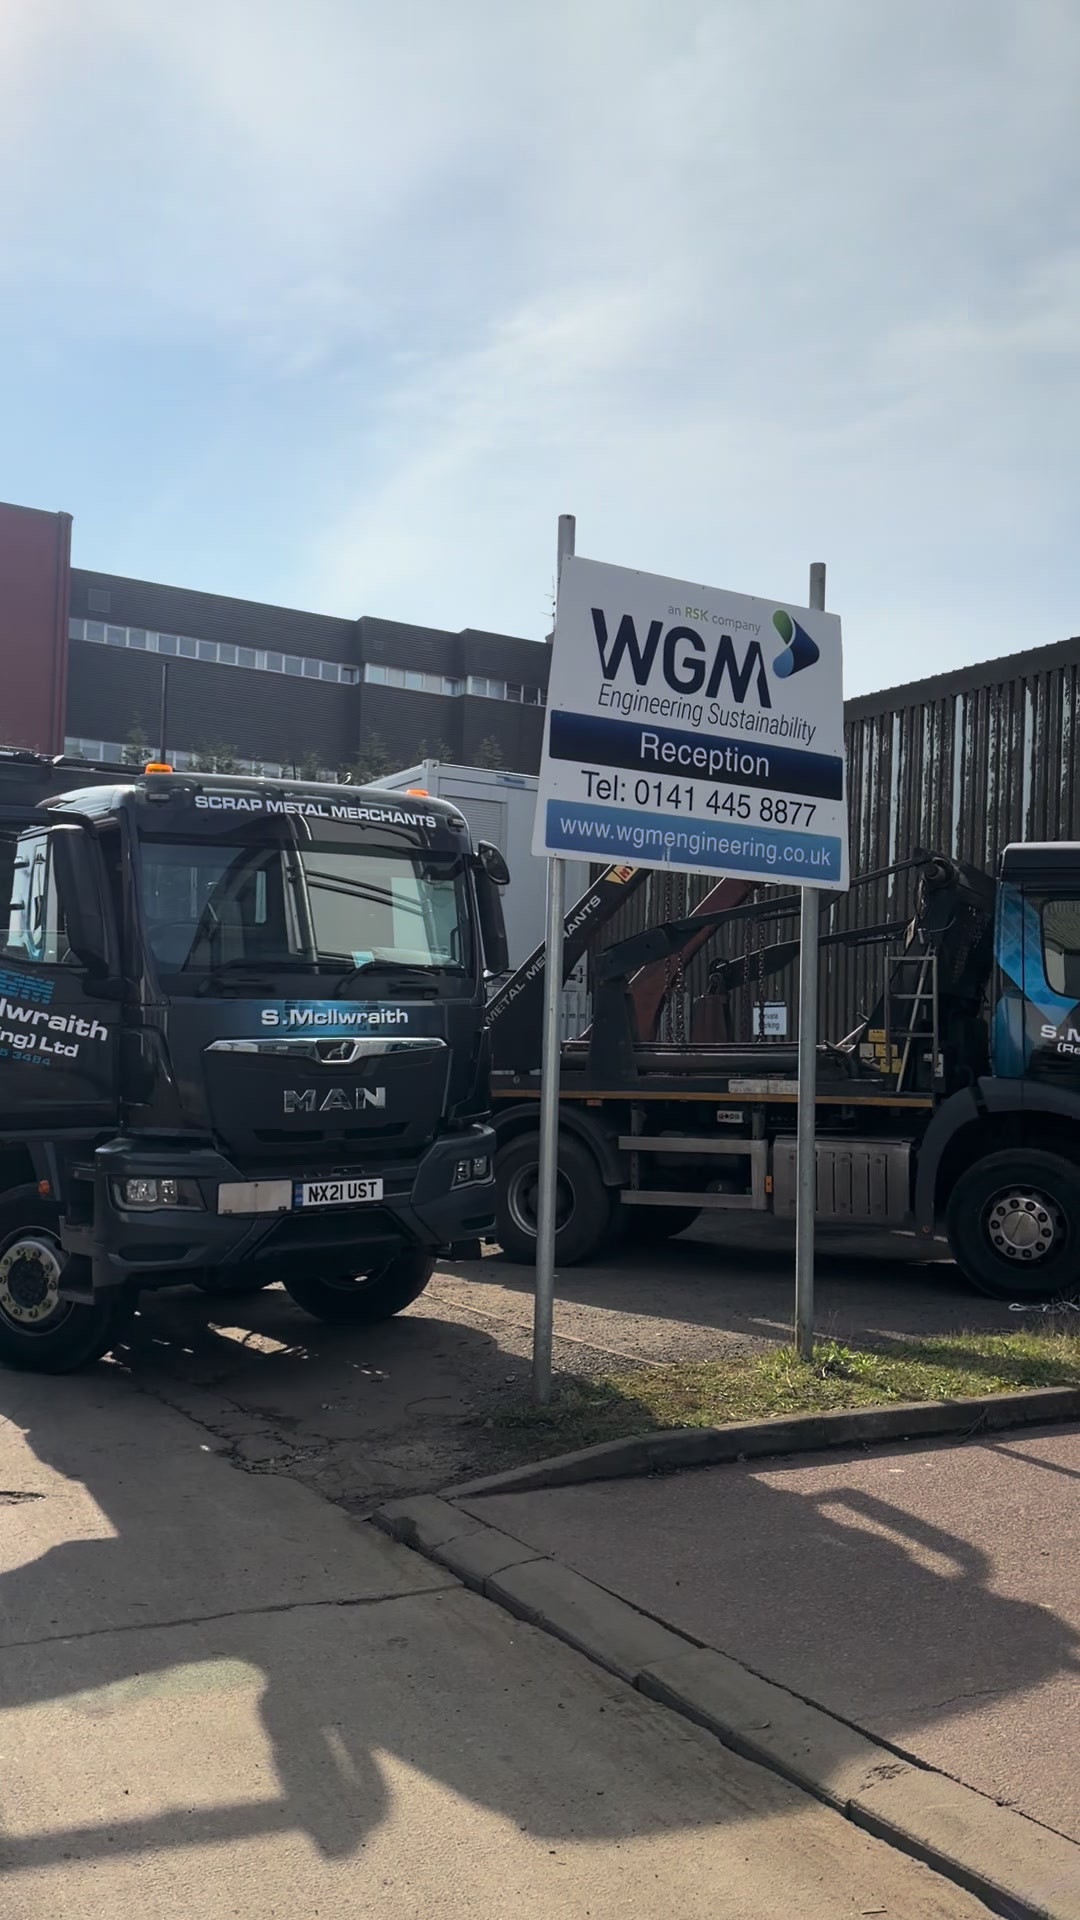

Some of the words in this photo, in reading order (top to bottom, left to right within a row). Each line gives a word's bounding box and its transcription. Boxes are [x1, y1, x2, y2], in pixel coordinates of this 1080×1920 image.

[667, 605, 682, 616] an
[684, 606, 709, 622] RSK
[711, 614, 762, 636] company
[591, 607, 772, 709] WGM
[598, 683, 703, 727] Engineering
[707, 702, 817, 746] Sustainability
[640, 731, 770, 777] Reception
[195, 795, 263, 812] SCRAP
[266, 801, 329, 817] METAL
[331, 805, 437, 828] MERCHANTS
[581, 769, 626, 802] Tel:
[634, 779, 694, 811] 0141
[706, 789, 751, 819] 445
[759, 797, 817, 827] 8877
[560, 816, 831, 866] www.wgmengineering.co.uk
[485, 982, 526, 1026] METAL
[39, 1037, 79, 1058] Ltd
[283, 1086, 386, 1113] MAN
[308, 1183, 344, 1203] NX21
[349, 1181, 378, 1199] UST
